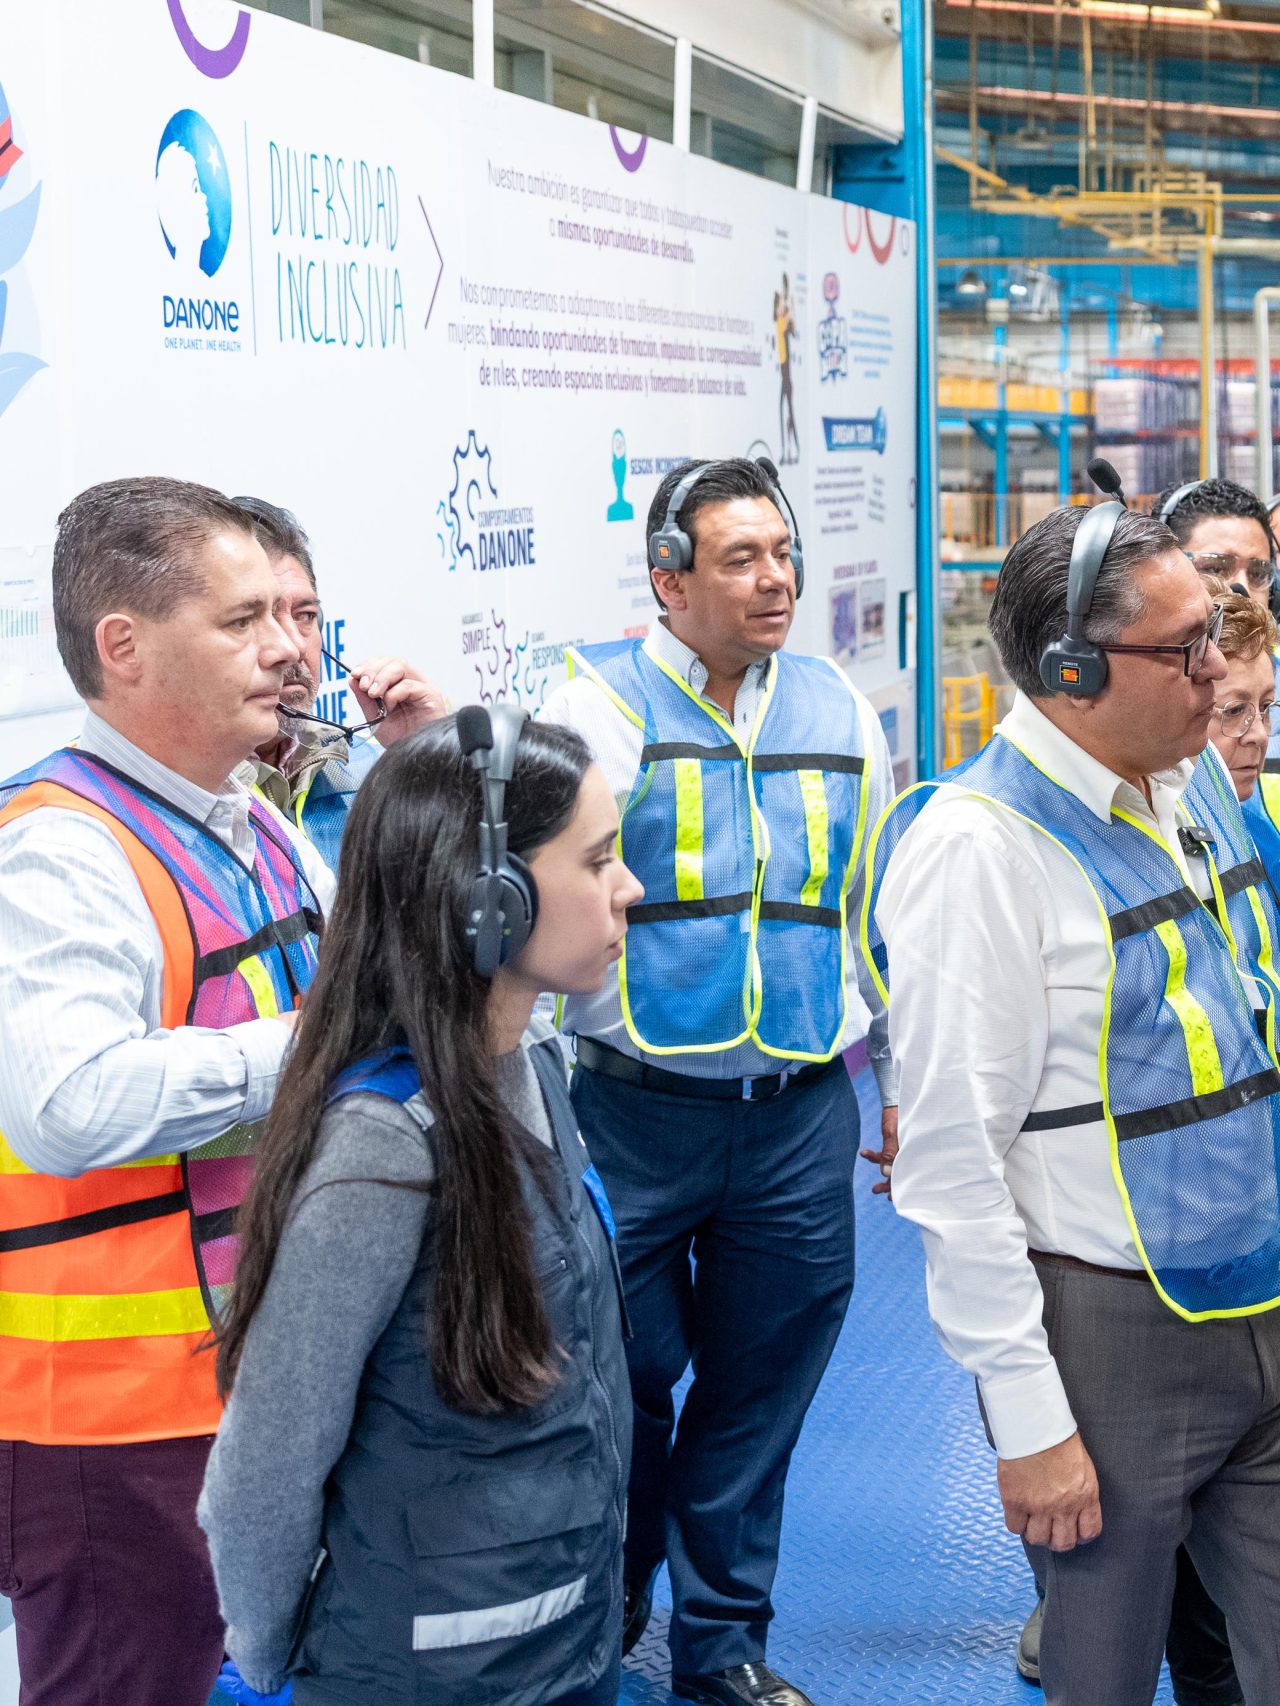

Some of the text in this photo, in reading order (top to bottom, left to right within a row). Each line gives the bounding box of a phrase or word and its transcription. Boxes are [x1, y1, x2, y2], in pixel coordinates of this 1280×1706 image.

[269, 140, 399, 252] DIVERSIDAD
[487, 158, 526, 193] Nuestra
[570, 184, 580, 205] es
[558, 212, 592, 244] mismas
[593, 225, 650, 256] oportunidades
[651, 232, 660, 257] de
[277, 251, 406, 350] INCLUSIVA
[460, 275, 480, 304] Nos
[164, 336, 179, 349] ONE
[218, 340, 242, 353] HEALTH
[542, 327, 608, 357] oportunidades
[609, 328, 619, 355] de
[480, 357, 491, 386] de
[521, 361, 563, 388] creando
[564, 364, 604, 396] espacios
[605, 364, 643, 392] inclusivos
[630, 456, 653, 475] SESGOS
[478, 506, 534, 528] COMPORTAMIENTOS
[479, 528, 536, 571] DANONE
[462, 627, 491, 655] SIMPLE
